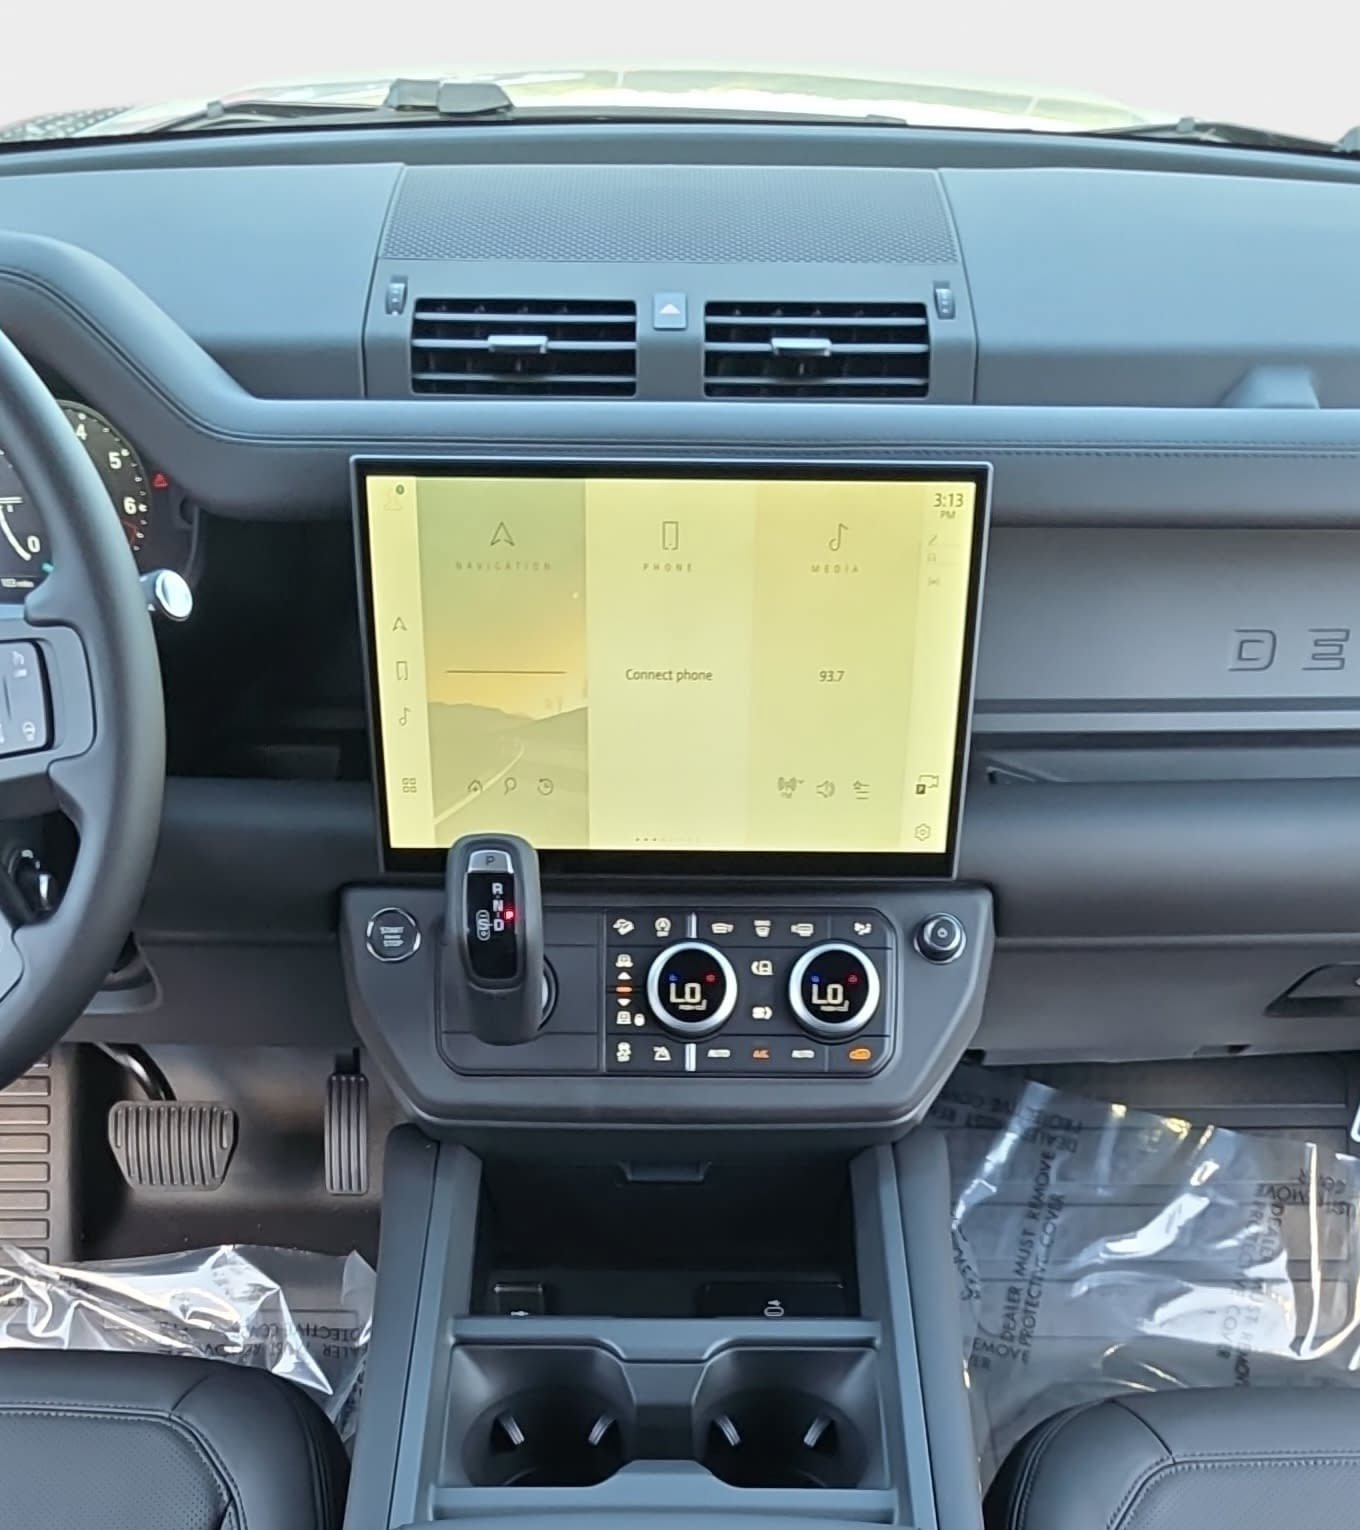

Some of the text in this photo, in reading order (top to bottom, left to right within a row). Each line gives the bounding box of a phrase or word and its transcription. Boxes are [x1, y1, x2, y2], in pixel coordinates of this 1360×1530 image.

[76, 423, 88, 441] 4
[108, 451, 122, 469] 5
[123, 496, 137, 514] 6
[933, 492, 964, 509] 3:13
[939, 510, 956, 520] PM
[26, 535, 40, 553] 0
[454, 562, 553, 573] NAVIGATION
[642, 562, 694, 573] PHONE
[811, 564, 861, 575] MEDIA
[625, 667, 714, 685] Connect phone
[819, 669, 844, 684] 93.7
[485, 855, 495, 866] P
[492, 882, 503, 895] R
[493, 899, 504, 912] N
[493, 918, 505, 931] D
[669, 981, 702, 1004] LO
[811, 983, 844, 1005] LO
[1000, 1150, 1056, 1343] DEALER MUST REMOVE
[1018, 1253, 1047, 1347] PROTECTIVE
